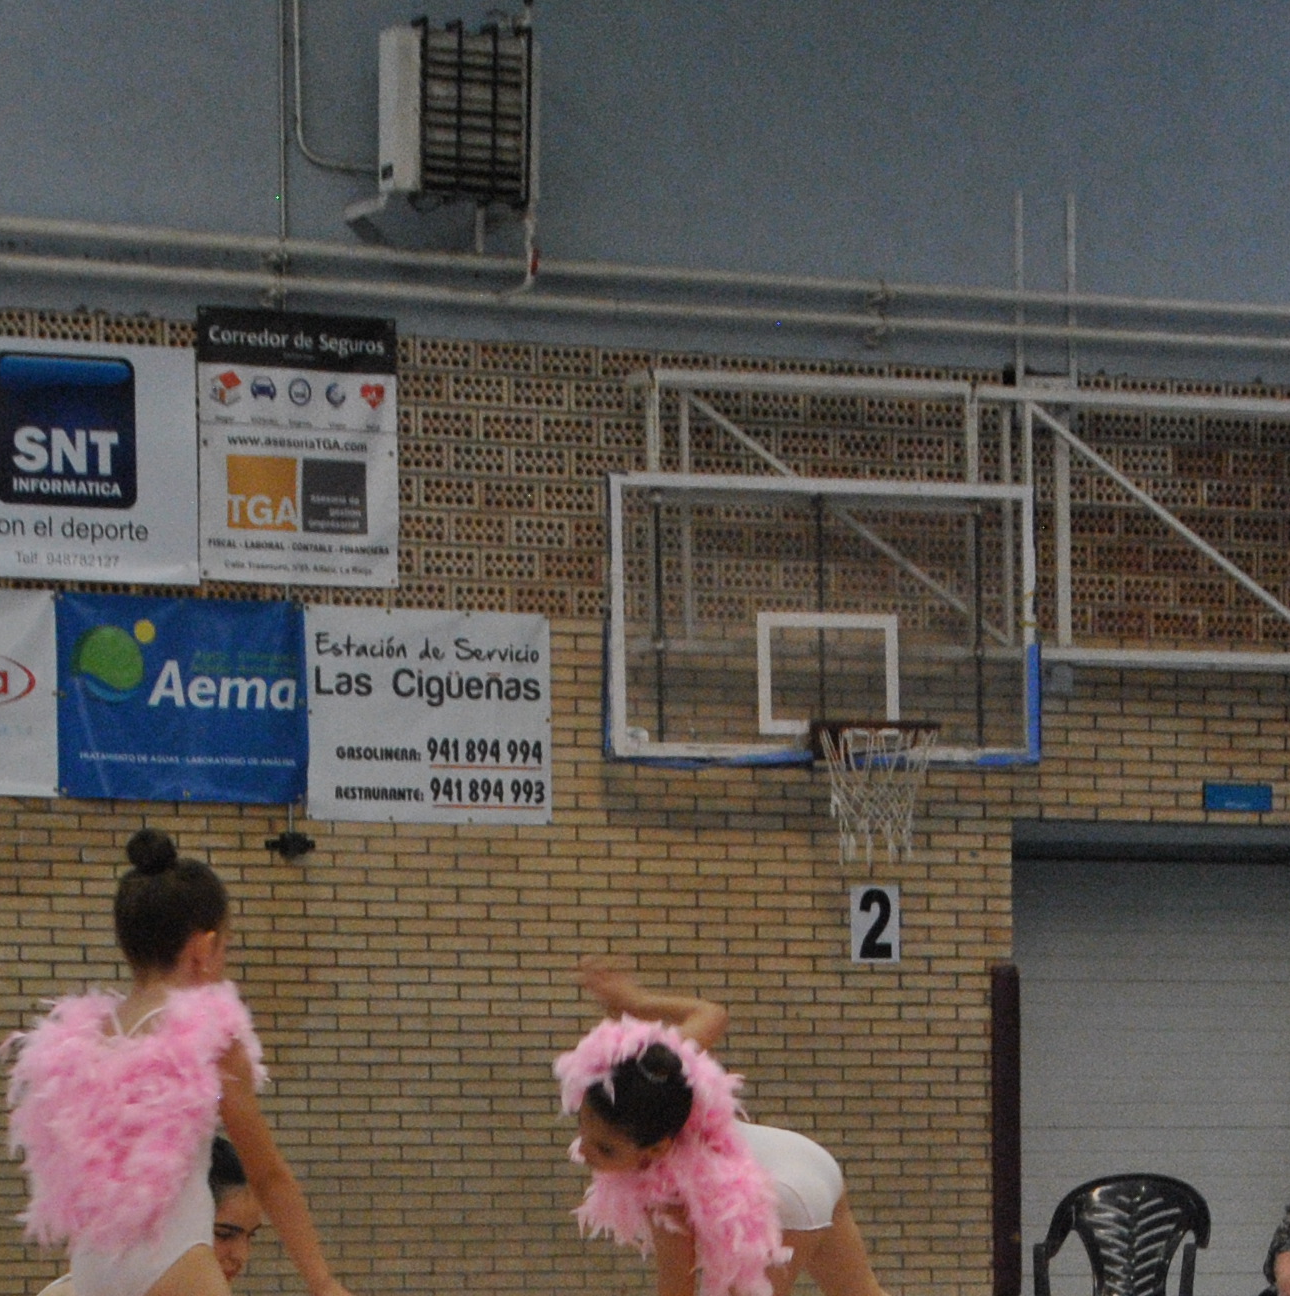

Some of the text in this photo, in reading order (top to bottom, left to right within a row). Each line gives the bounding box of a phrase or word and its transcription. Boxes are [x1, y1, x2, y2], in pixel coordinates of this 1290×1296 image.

[209, 324, 385, 357] Corredor de Seguros
[12, 425, 119, 476] SNT
[12, 477, 122, 498] INFORMATICA
[227, 493, 297, 526] TGA
[33, 515, 53, 537] el
[61, 516, 149, 544] deporte
[315, 631, 540, 664] Estación de Servicio
[148, 660, 296, 711] Aema
[314, 665, 541, 707] Las Cigüeñas
[427, 737, 459, 762] 941
[465, 738, 500, 764] 894
[507, 739, 543, 765] 994
[430, 777, 463, 802] 941
[469, 778, 504, 803] 894
[511, 779, 545, 805] 993
[859, 888, 893, 959] 2
